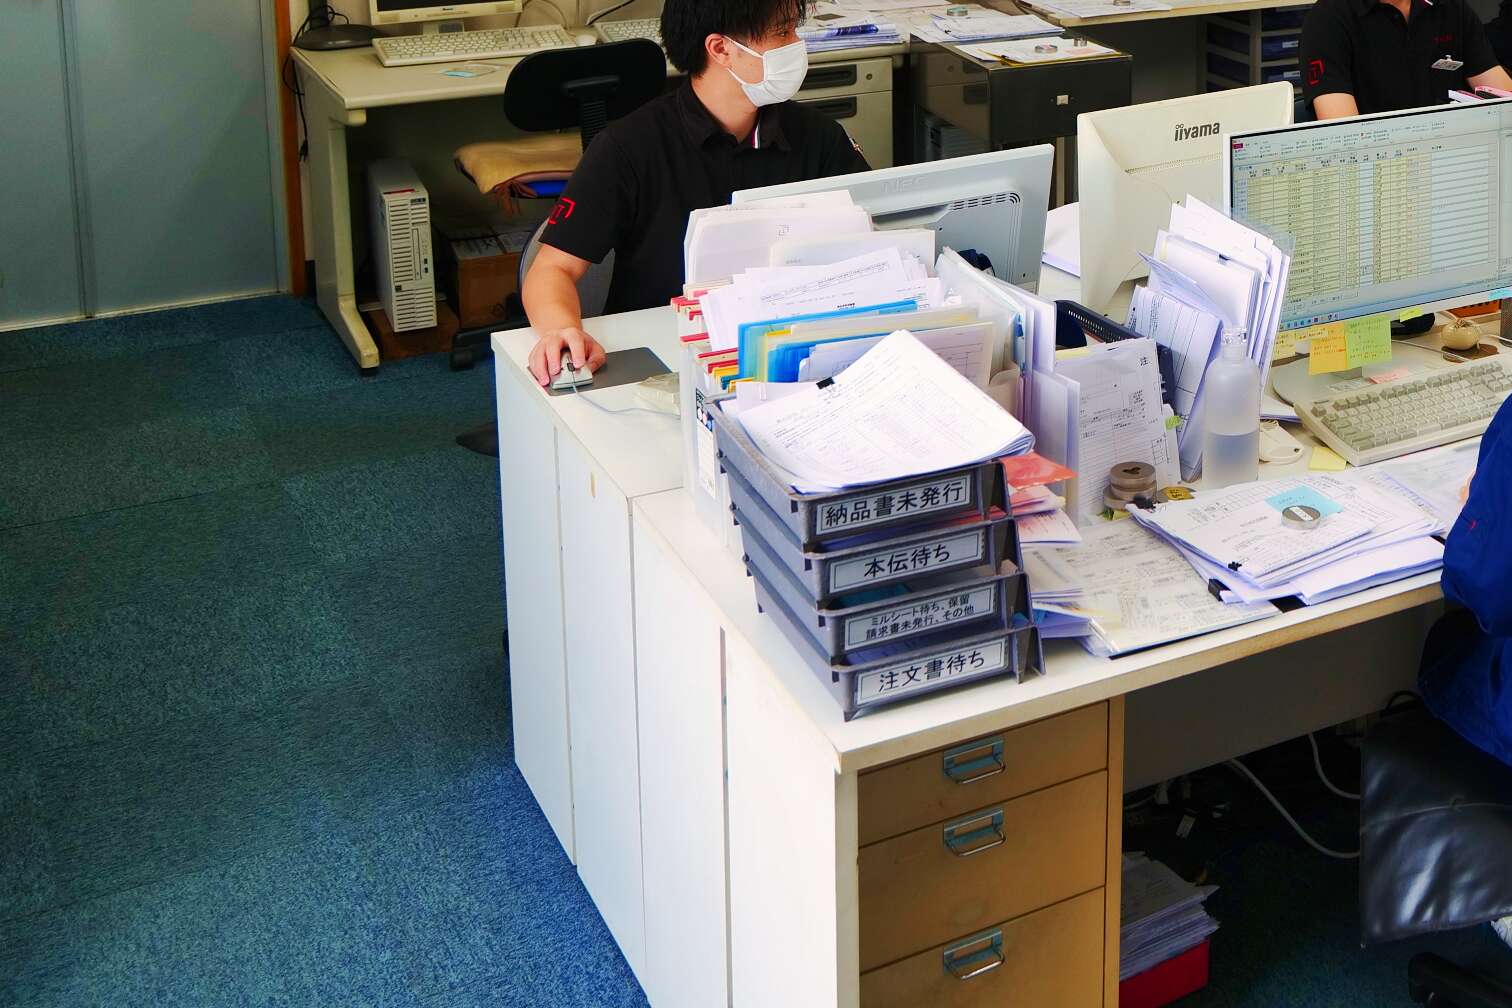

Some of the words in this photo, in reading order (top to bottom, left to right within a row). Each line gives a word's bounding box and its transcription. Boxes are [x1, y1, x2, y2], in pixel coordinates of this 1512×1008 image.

[1175, 123, 1220, 142] iiyama
[825, 481, 962, 528] 納品書未発行
[864, 544, 950, 577] 本伝待ち
[878, 650, 984, 692] 注文書待ち
